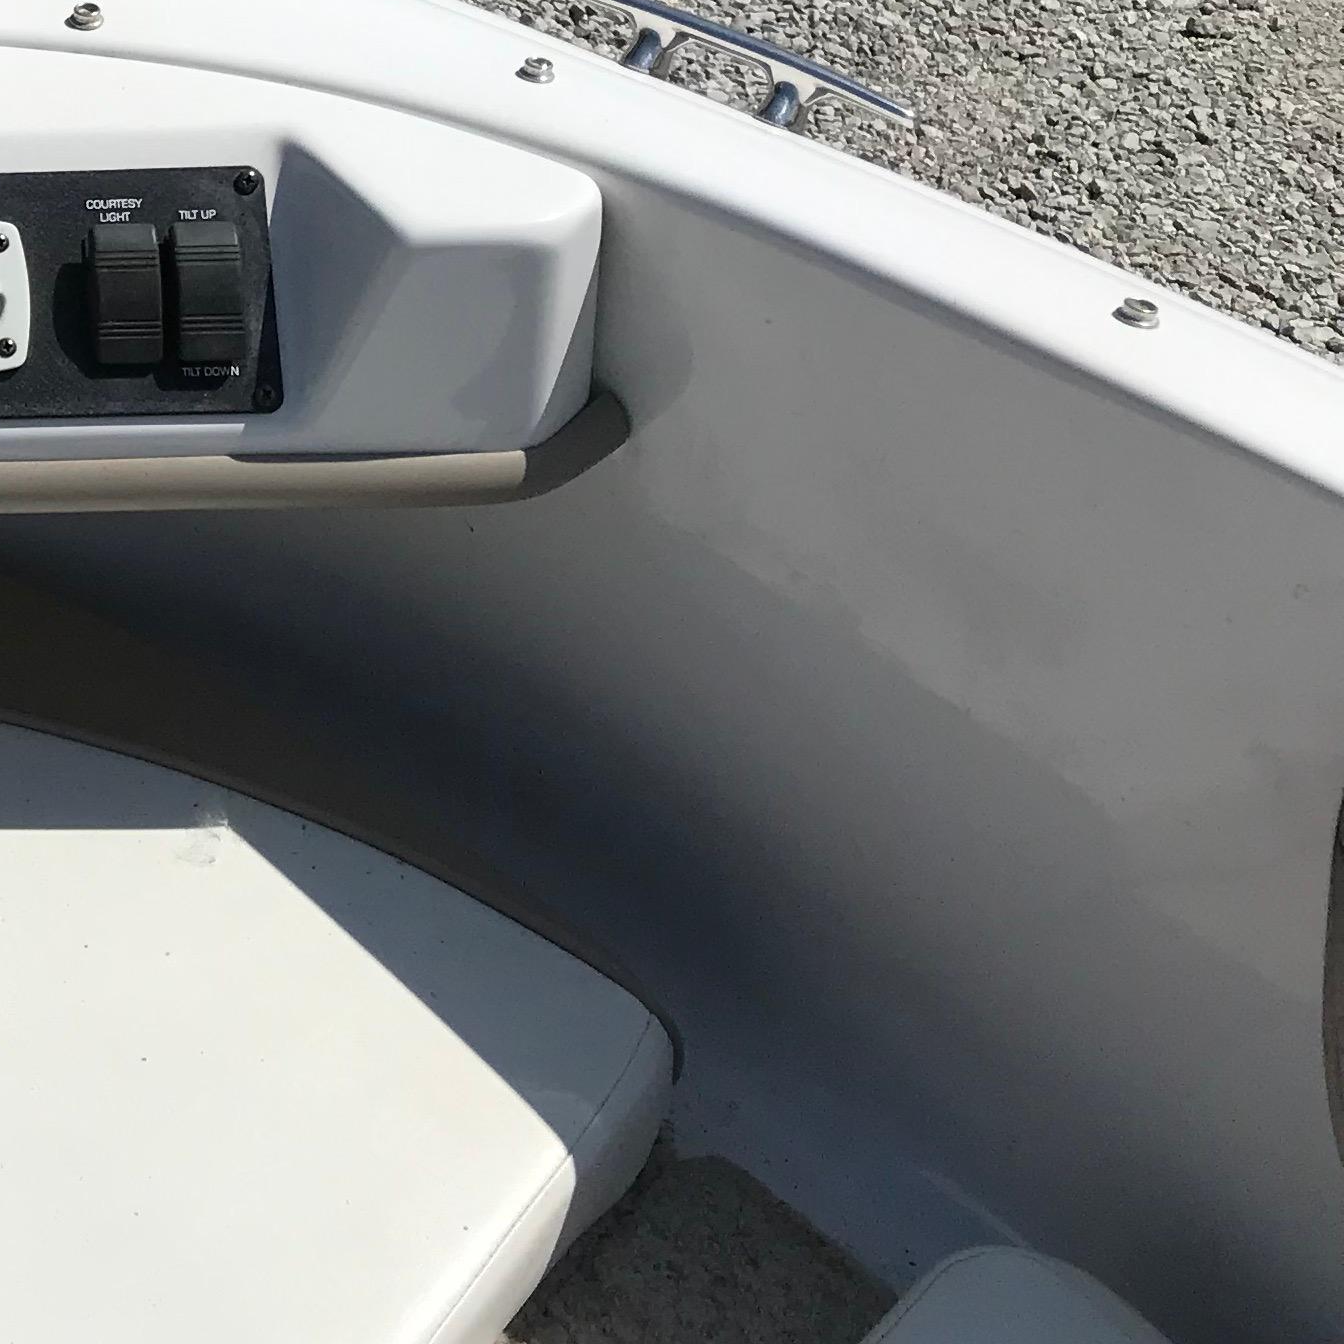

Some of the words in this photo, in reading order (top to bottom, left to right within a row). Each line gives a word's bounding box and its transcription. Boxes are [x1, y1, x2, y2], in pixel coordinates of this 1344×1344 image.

[85, 198, 143, 210] COURTESY
[99, 211, 131, 222] LIGHT
[178, 209, 199, 220] TILT
[200, 209, 217, 220] UP
[181, 366, 202, 377] TILT
[203, 365, 240, 377] DOWN
